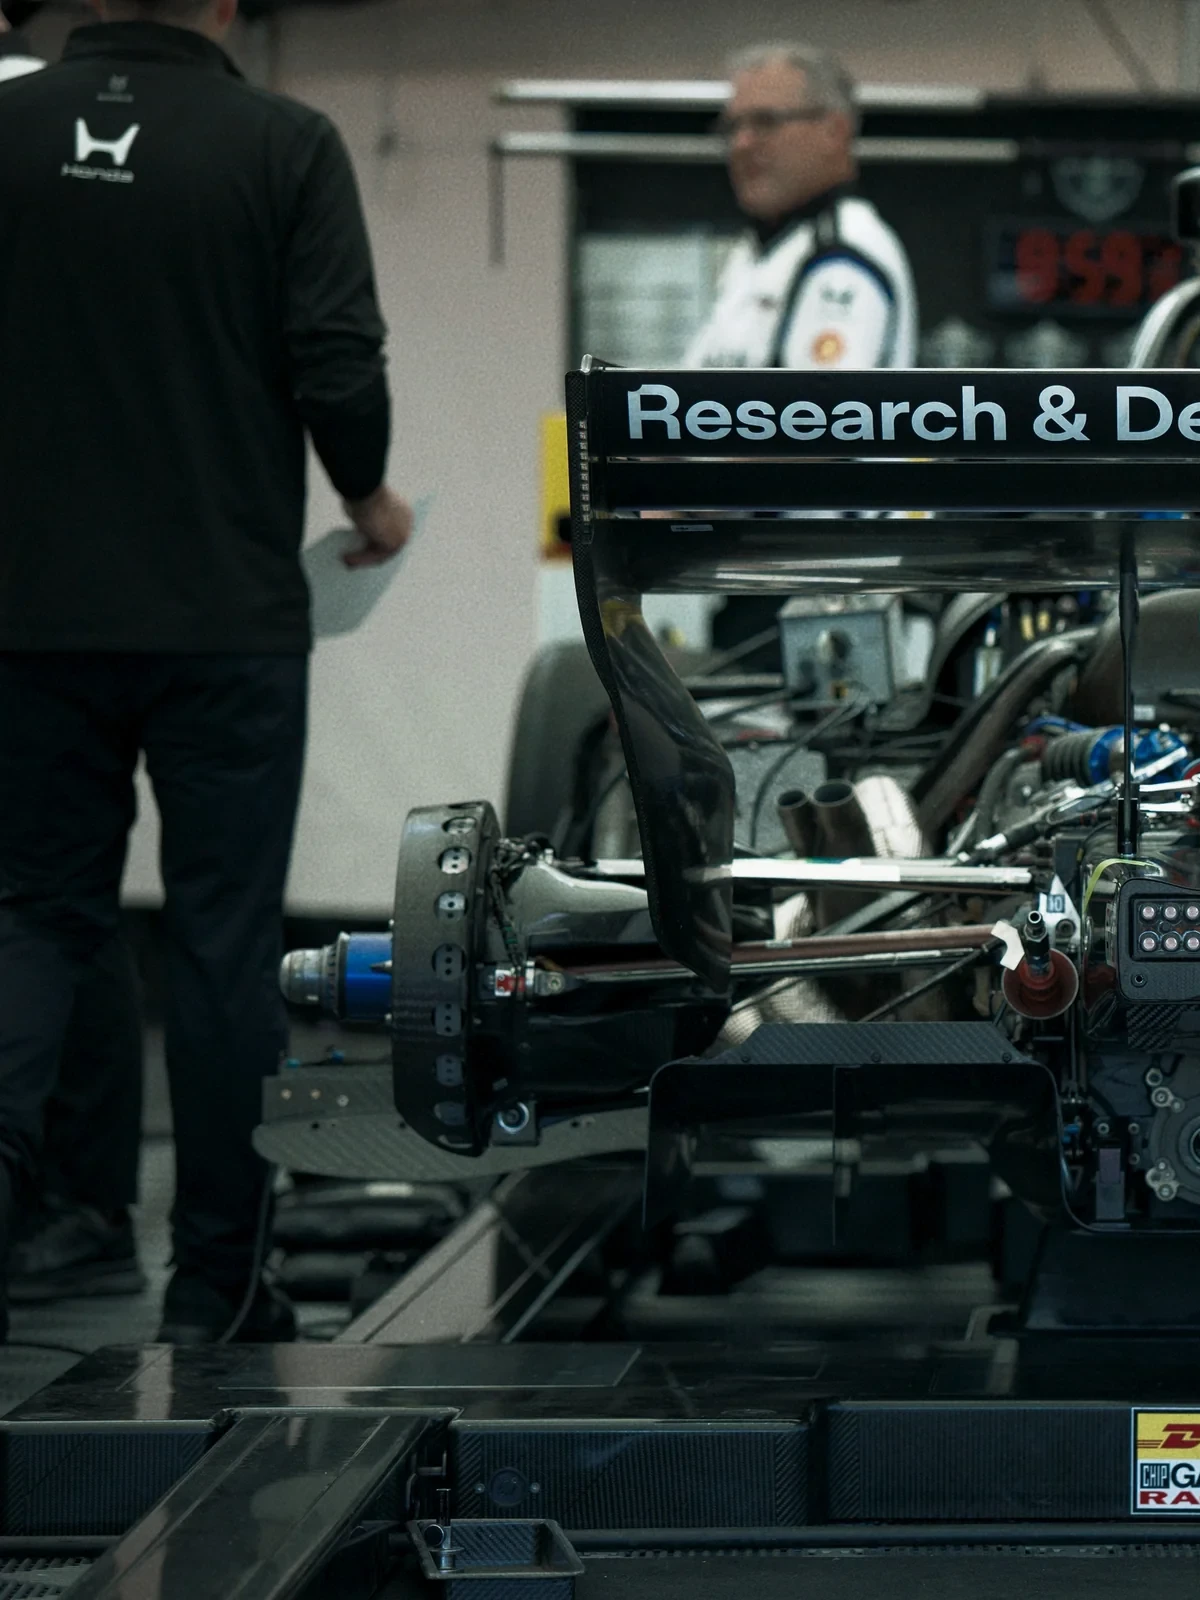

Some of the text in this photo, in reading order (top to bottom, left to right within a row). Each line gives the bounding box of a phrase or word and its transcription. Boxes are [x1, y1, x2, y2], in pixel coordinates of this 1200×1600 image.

[627, 384, 1006, 441] Research
[1033, 384, 1091, 442] &
[1141, 1463, 1169, 1488] CHIP
